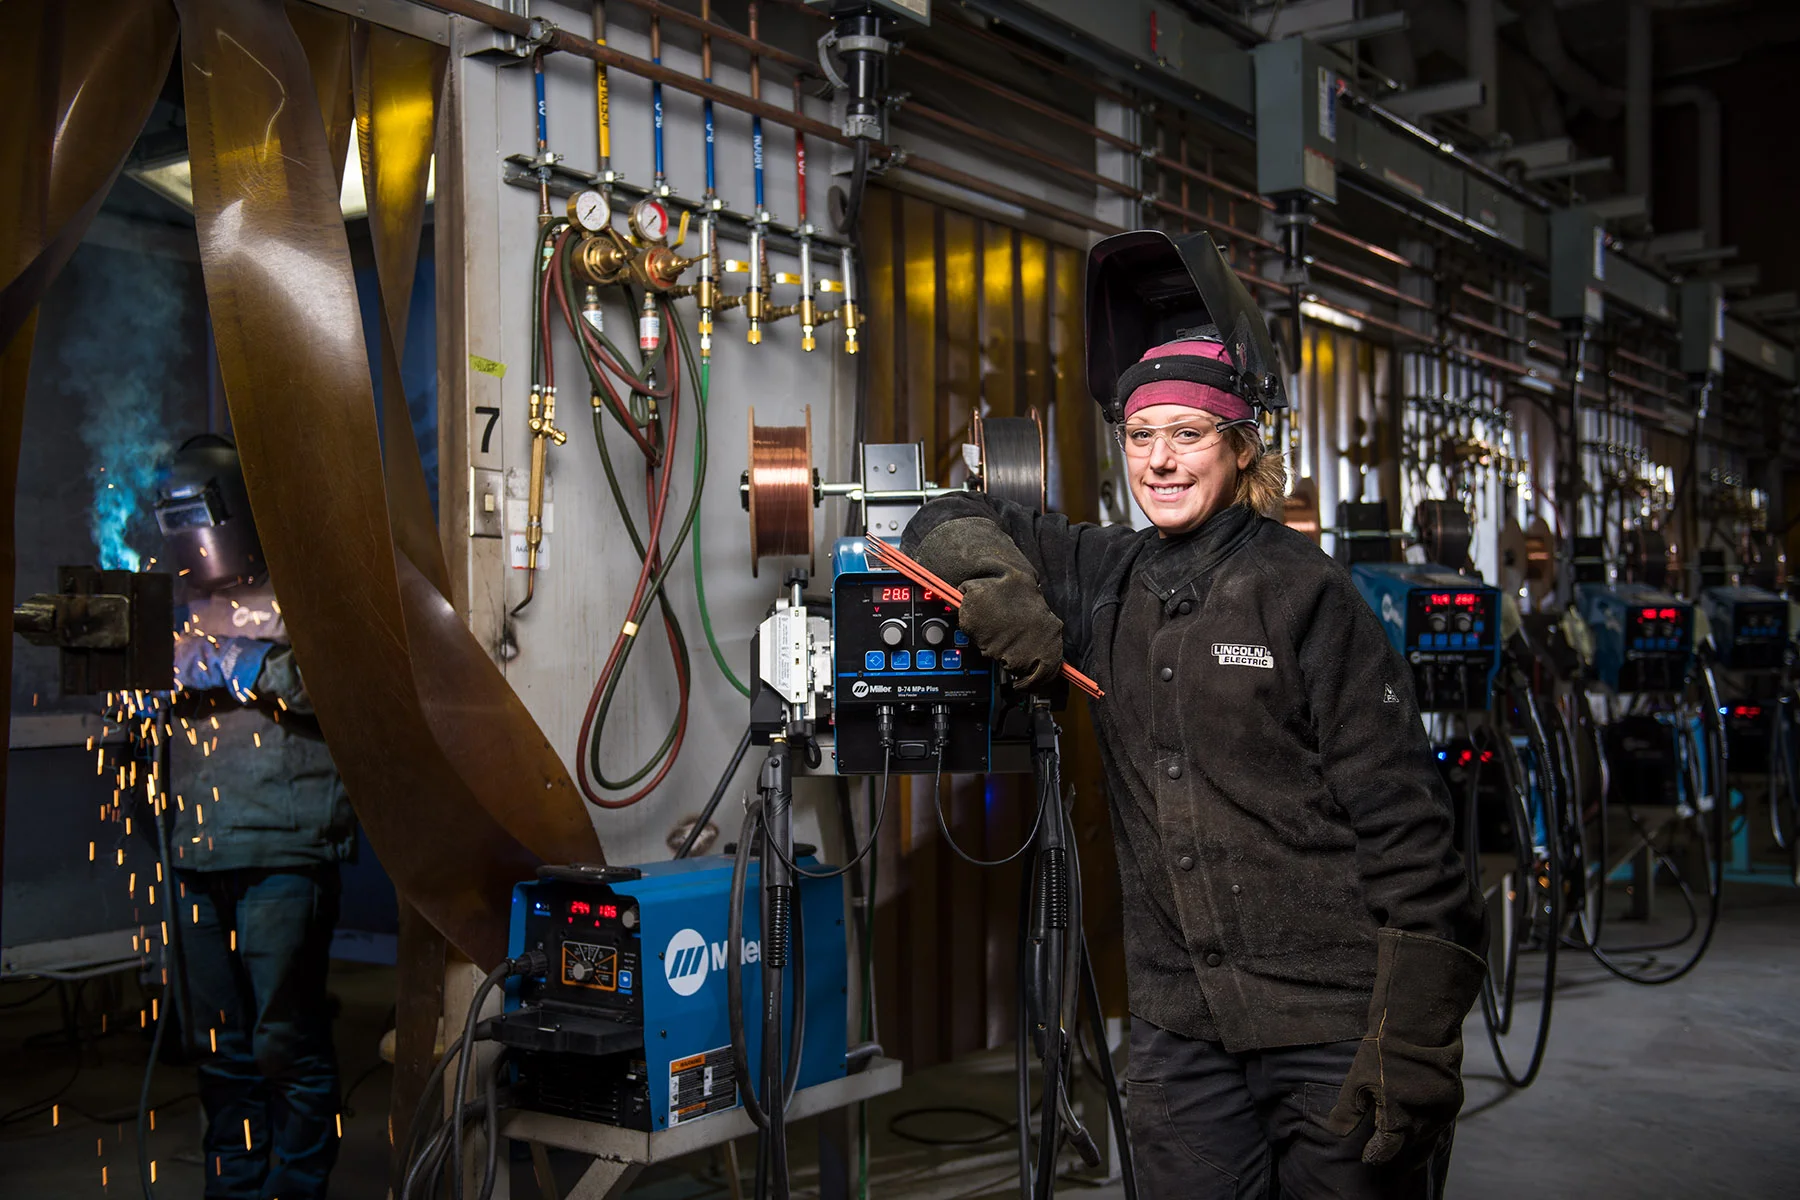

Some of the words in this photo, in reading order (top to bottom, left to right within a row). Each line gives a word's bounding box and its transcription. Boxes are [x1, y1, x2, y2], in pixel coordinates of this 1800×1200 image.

[754, 135, 763, 169] ARGON
[475, 406, 499, 453] 7
[1214, 645, 1264, 657] LINCOLN
[1224, 656, 1268, 666] ELECTRIC
[870, 685, 892, 693] Miller
[912, 685, 925, 693] MPa
